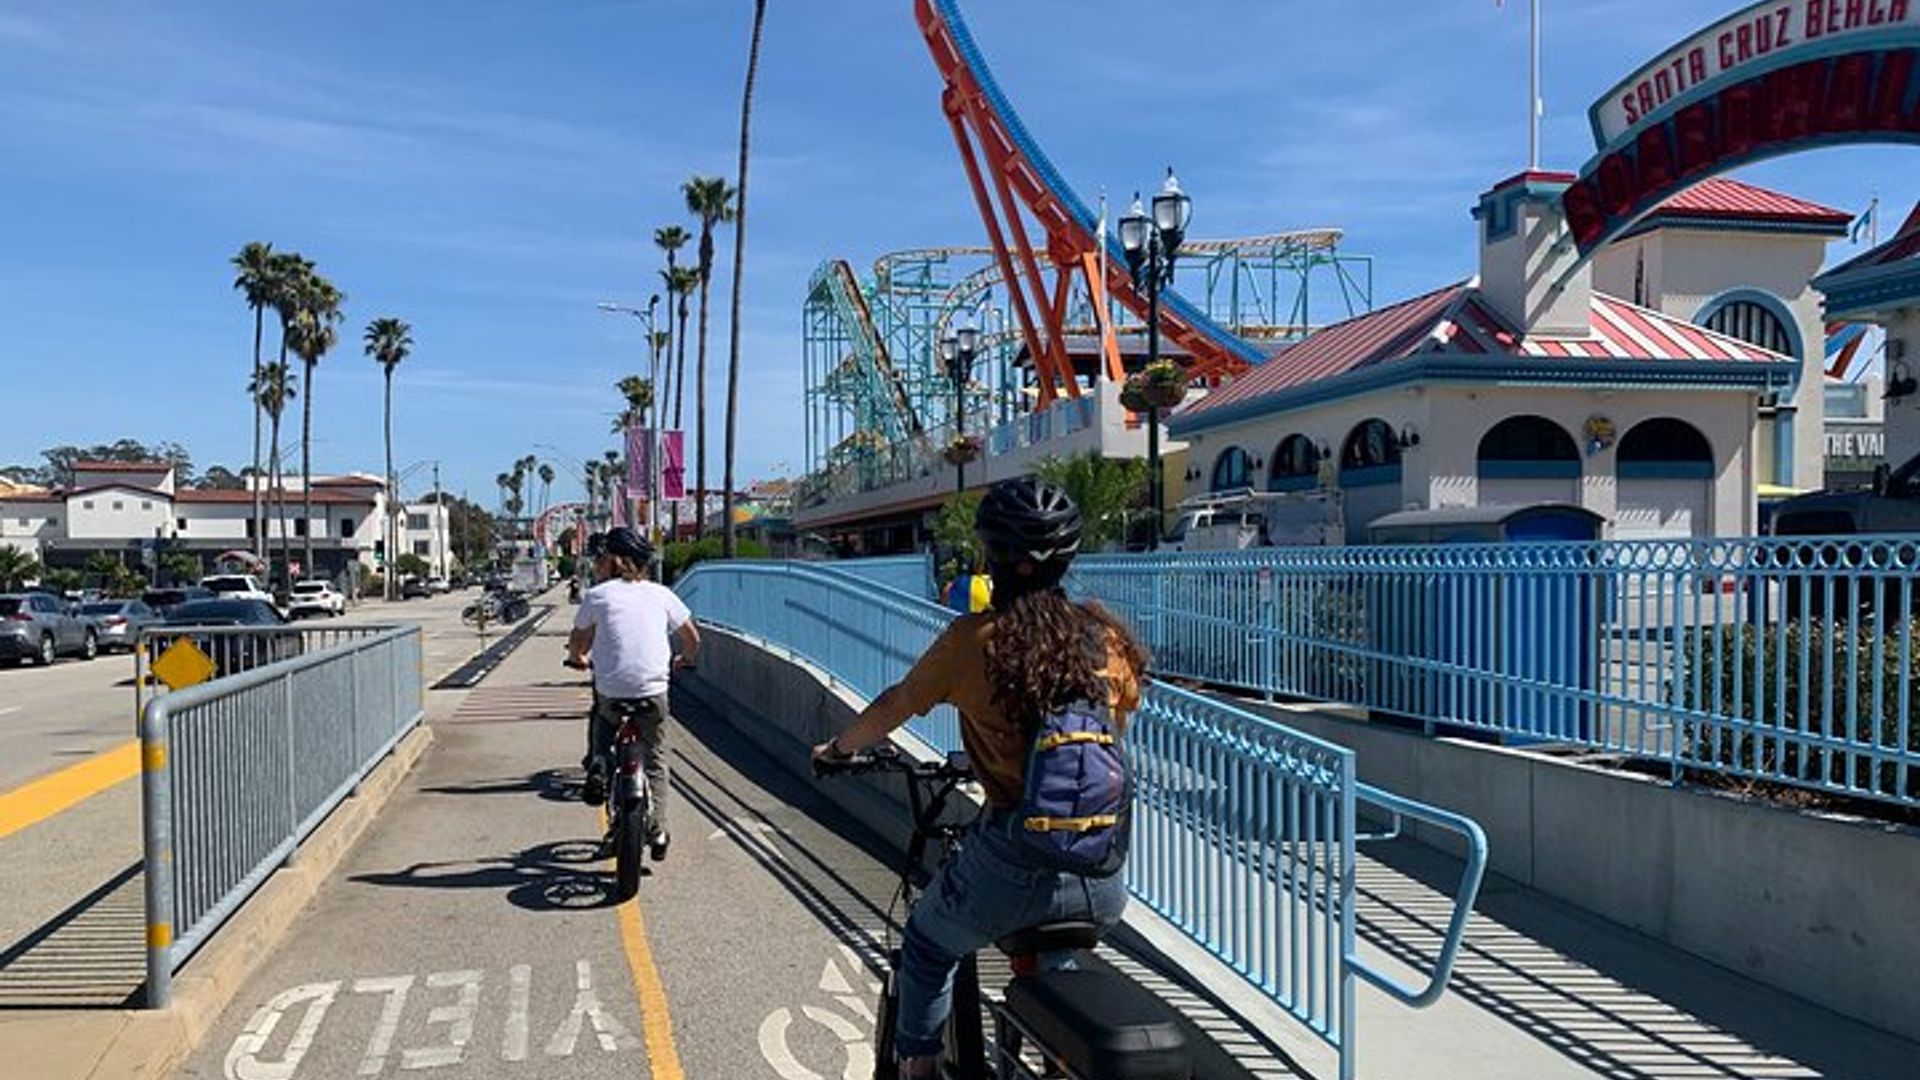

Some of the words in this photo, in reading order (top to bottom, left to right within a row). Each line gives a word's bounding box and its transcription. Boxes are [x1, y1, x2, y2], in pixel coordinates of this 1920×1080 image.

[1622, 46, 1707, 126] SANTA
[1717, 7, 1792, 71] CRUZ
[1823, 433, 1853, 456] THE
[223, 959, 642, 1080] YIELD
